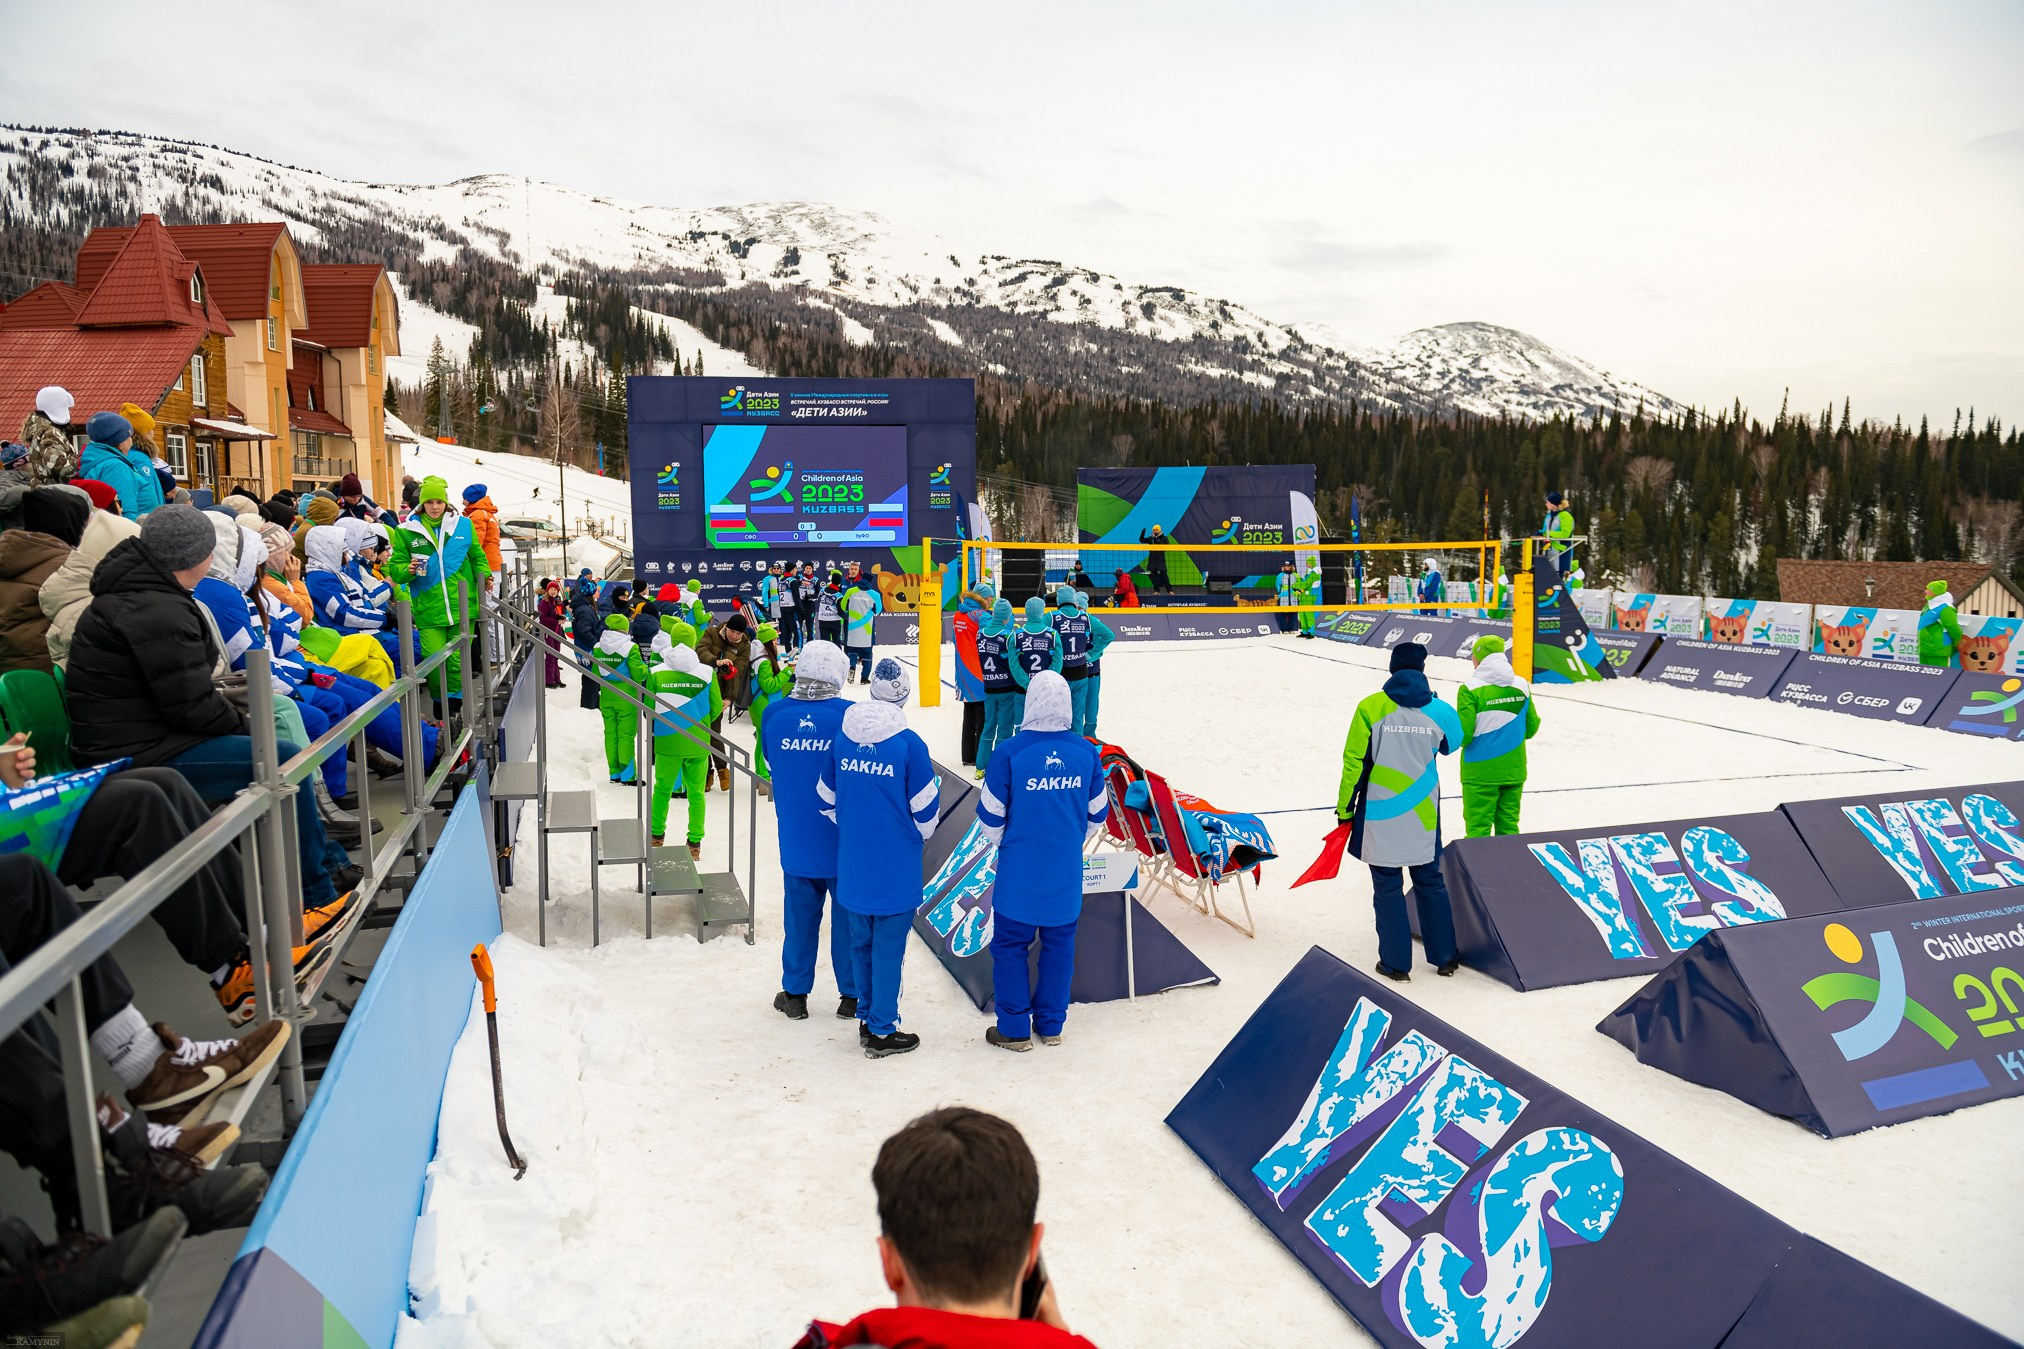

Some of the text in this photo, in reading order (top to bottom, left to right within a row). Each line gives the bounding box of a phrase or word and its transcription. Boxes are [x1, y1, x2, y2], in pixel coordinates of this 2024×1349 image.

[746, 399, 780, 409] 2023
[790, 407, 868, 418] «ДЕТИ АЗИИ»
[801, 474, 863, 482] Children of Asia
[802, 484, 864, 502] 2023
[1243, 523, 1263, 531] Дети
[1243, 531, 1283, 544] 2023
[1538, 621, 1561, 629] 2023
[1584, 615, 1603, 623] 2023
[1337, 621, 1372, 634] 2023
[1670, 624, 1692, 633] 2023
[1068, 637, 1076, 652] 1
[1774, 633, 1800, 643] 2023
[1676, 640, 1707, 649] CHILDREN
[1717, 643, 1733, 651] ASIA
[1733, 645, 1763, 654] KUZBASS
[1763, 648, 1780, 656] 2023
[983, 656, 997, 671] 4
[1030, 654, 1042, 670] 2
[1601, 648, 1632, 667] 23
[1664, 665, 1700, 676] NATURAL
[1808, 654, 1849, 664] CHILDREN
[1861, 660, 1881, 668] ASIA
[1881, 662, 1921, 673] KUZBASS
[1920, 667, 1943, 676] 2023
[1660, 672, 1697, 683] ADVANCE
[1786, 683, 1812, 692] РЦСС
[1486, 697, 1515, 706] KUZBASS
[1780, 690, 1828, 703] КУЗБАССА
[1854, 695, 1890, 708] СБЕР
[1383, 724, 1433, 735] KUZBASS
[840, 758, 895, 777] SAKHA
[1026, 776, 1082, 791] SAKHA
[1841, 793, 2024, 900] YES
[1527, 826, 1788, 960] YES
[1922, 917, 1951, 928] WINTER
[1950, 908, 2004, 924] INTERNATIONAL
[1923, 922, 2024, 961] Children of
[1953, 966, 2024, 1038] 20
[1252, 996, 1624, 1349] YES
